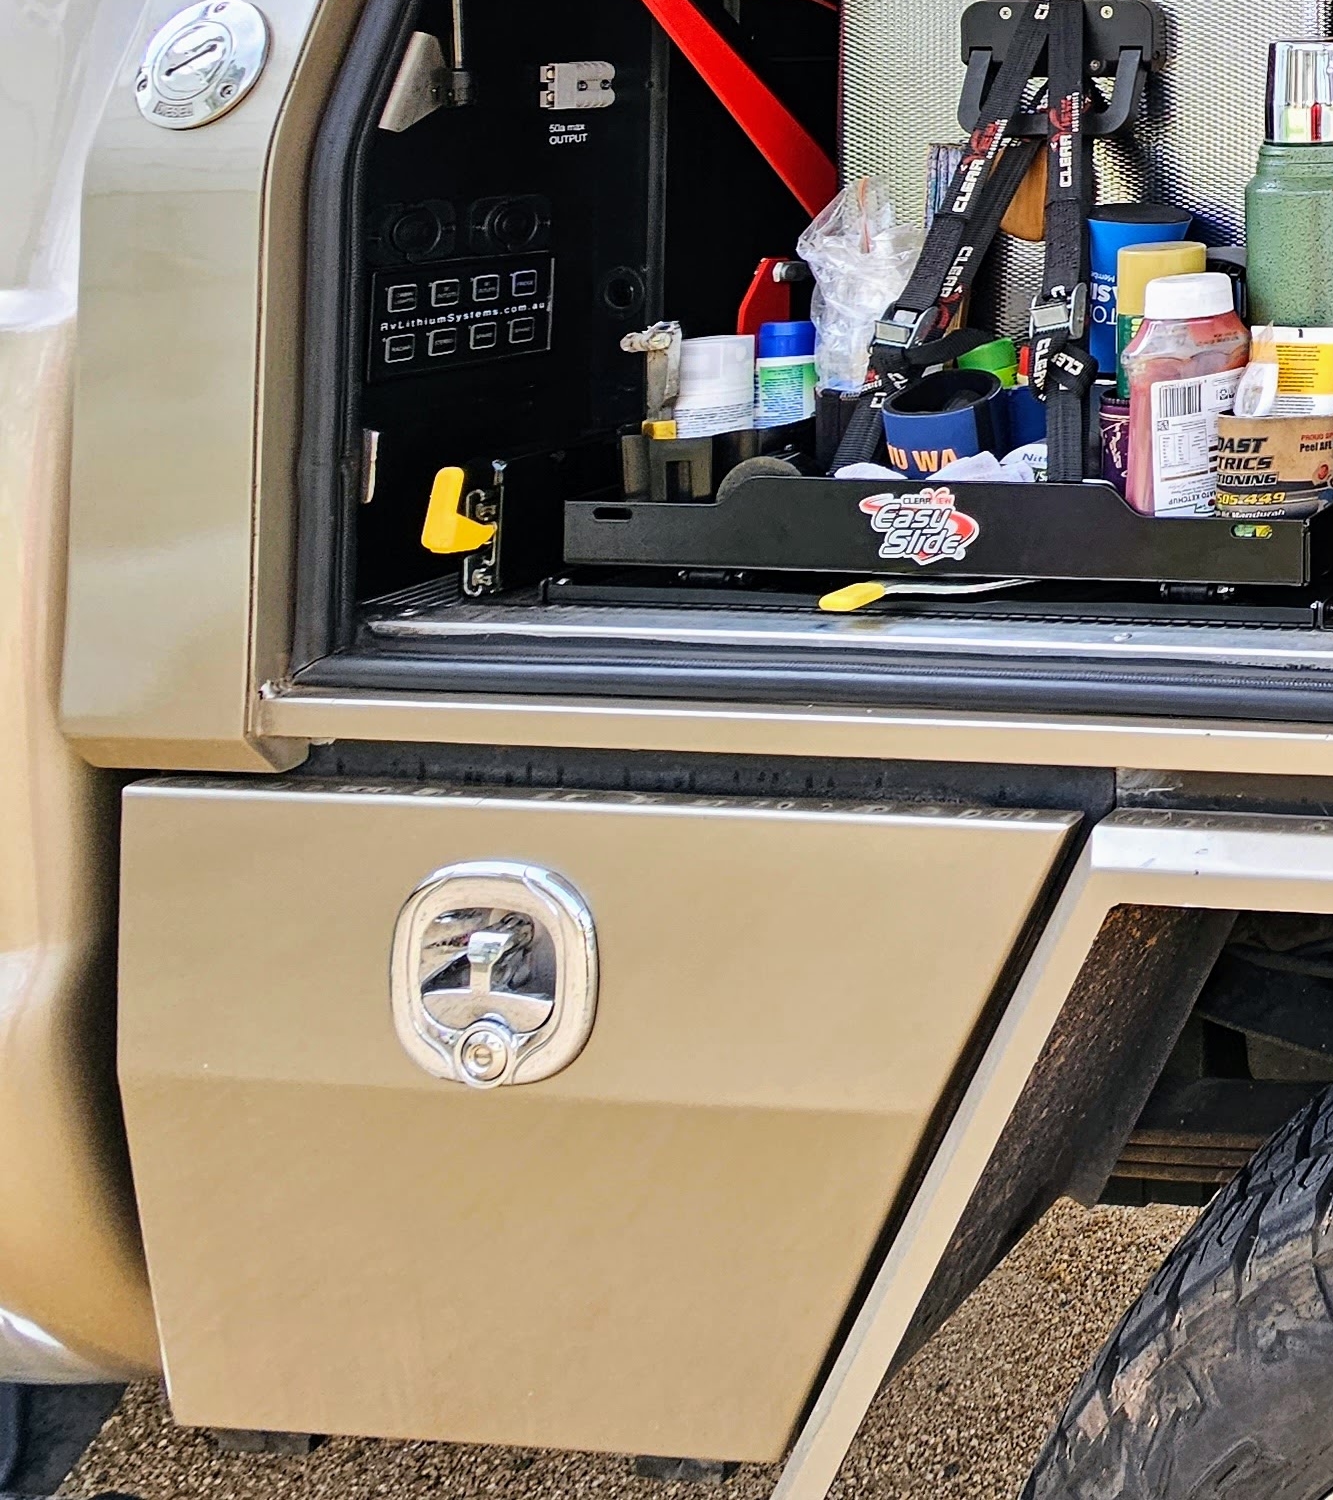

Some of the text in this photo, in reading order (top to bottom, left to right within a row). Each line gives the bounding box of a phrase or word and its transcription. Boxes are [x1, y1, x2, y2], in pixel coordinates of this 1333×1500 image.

[549, 133, 588, 145] OUTPUT
[1168, 493, 1201, 506] KETCHUP
[1243, 491, 1286, 506] 449
[874, 502, 952, 534] Easy
[882, 528, 963, 555] Slide
